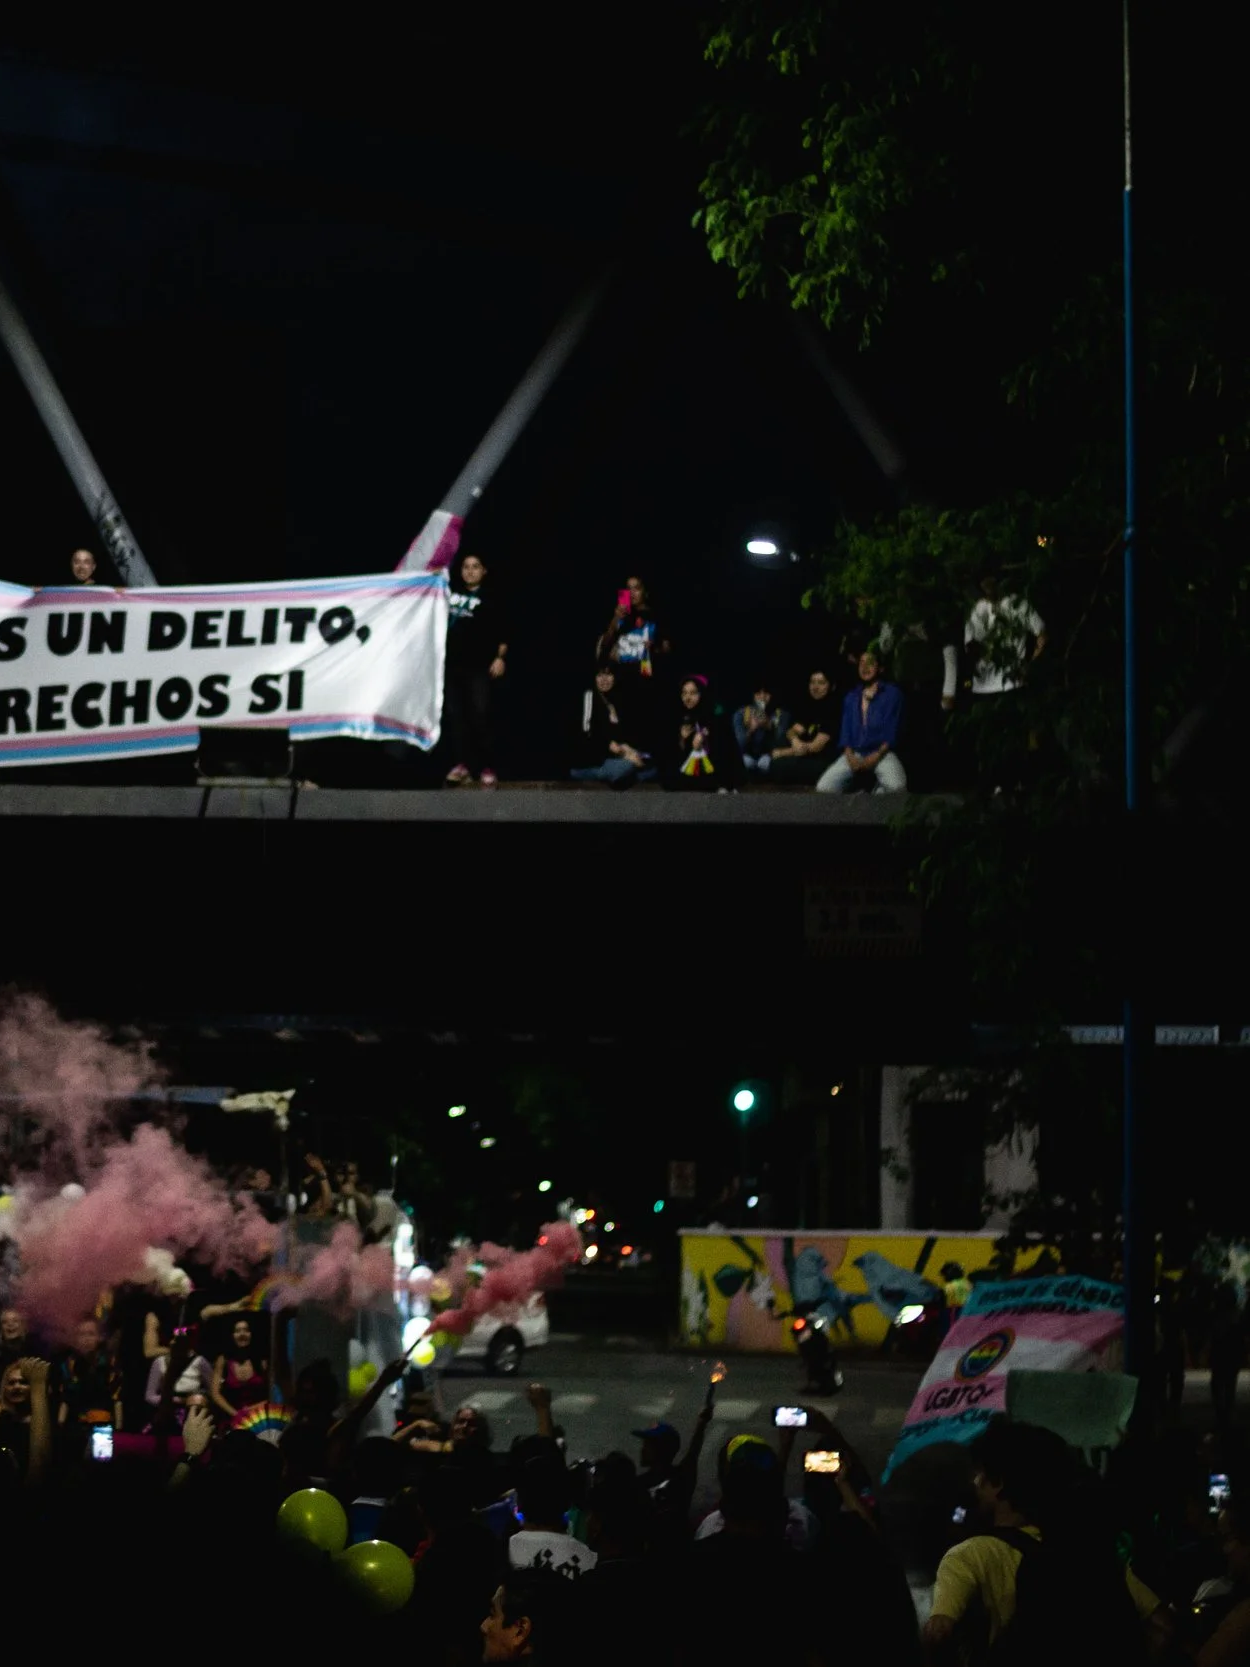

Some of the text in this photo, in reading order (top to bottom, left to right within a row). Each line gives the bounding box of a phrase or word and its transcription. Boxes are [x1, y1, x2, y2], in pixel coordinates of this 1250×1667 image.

[47, 611, 127, 656] UN
[147, 606, 371, 651] DELITO,
[248, 670, 304, 713] SI
